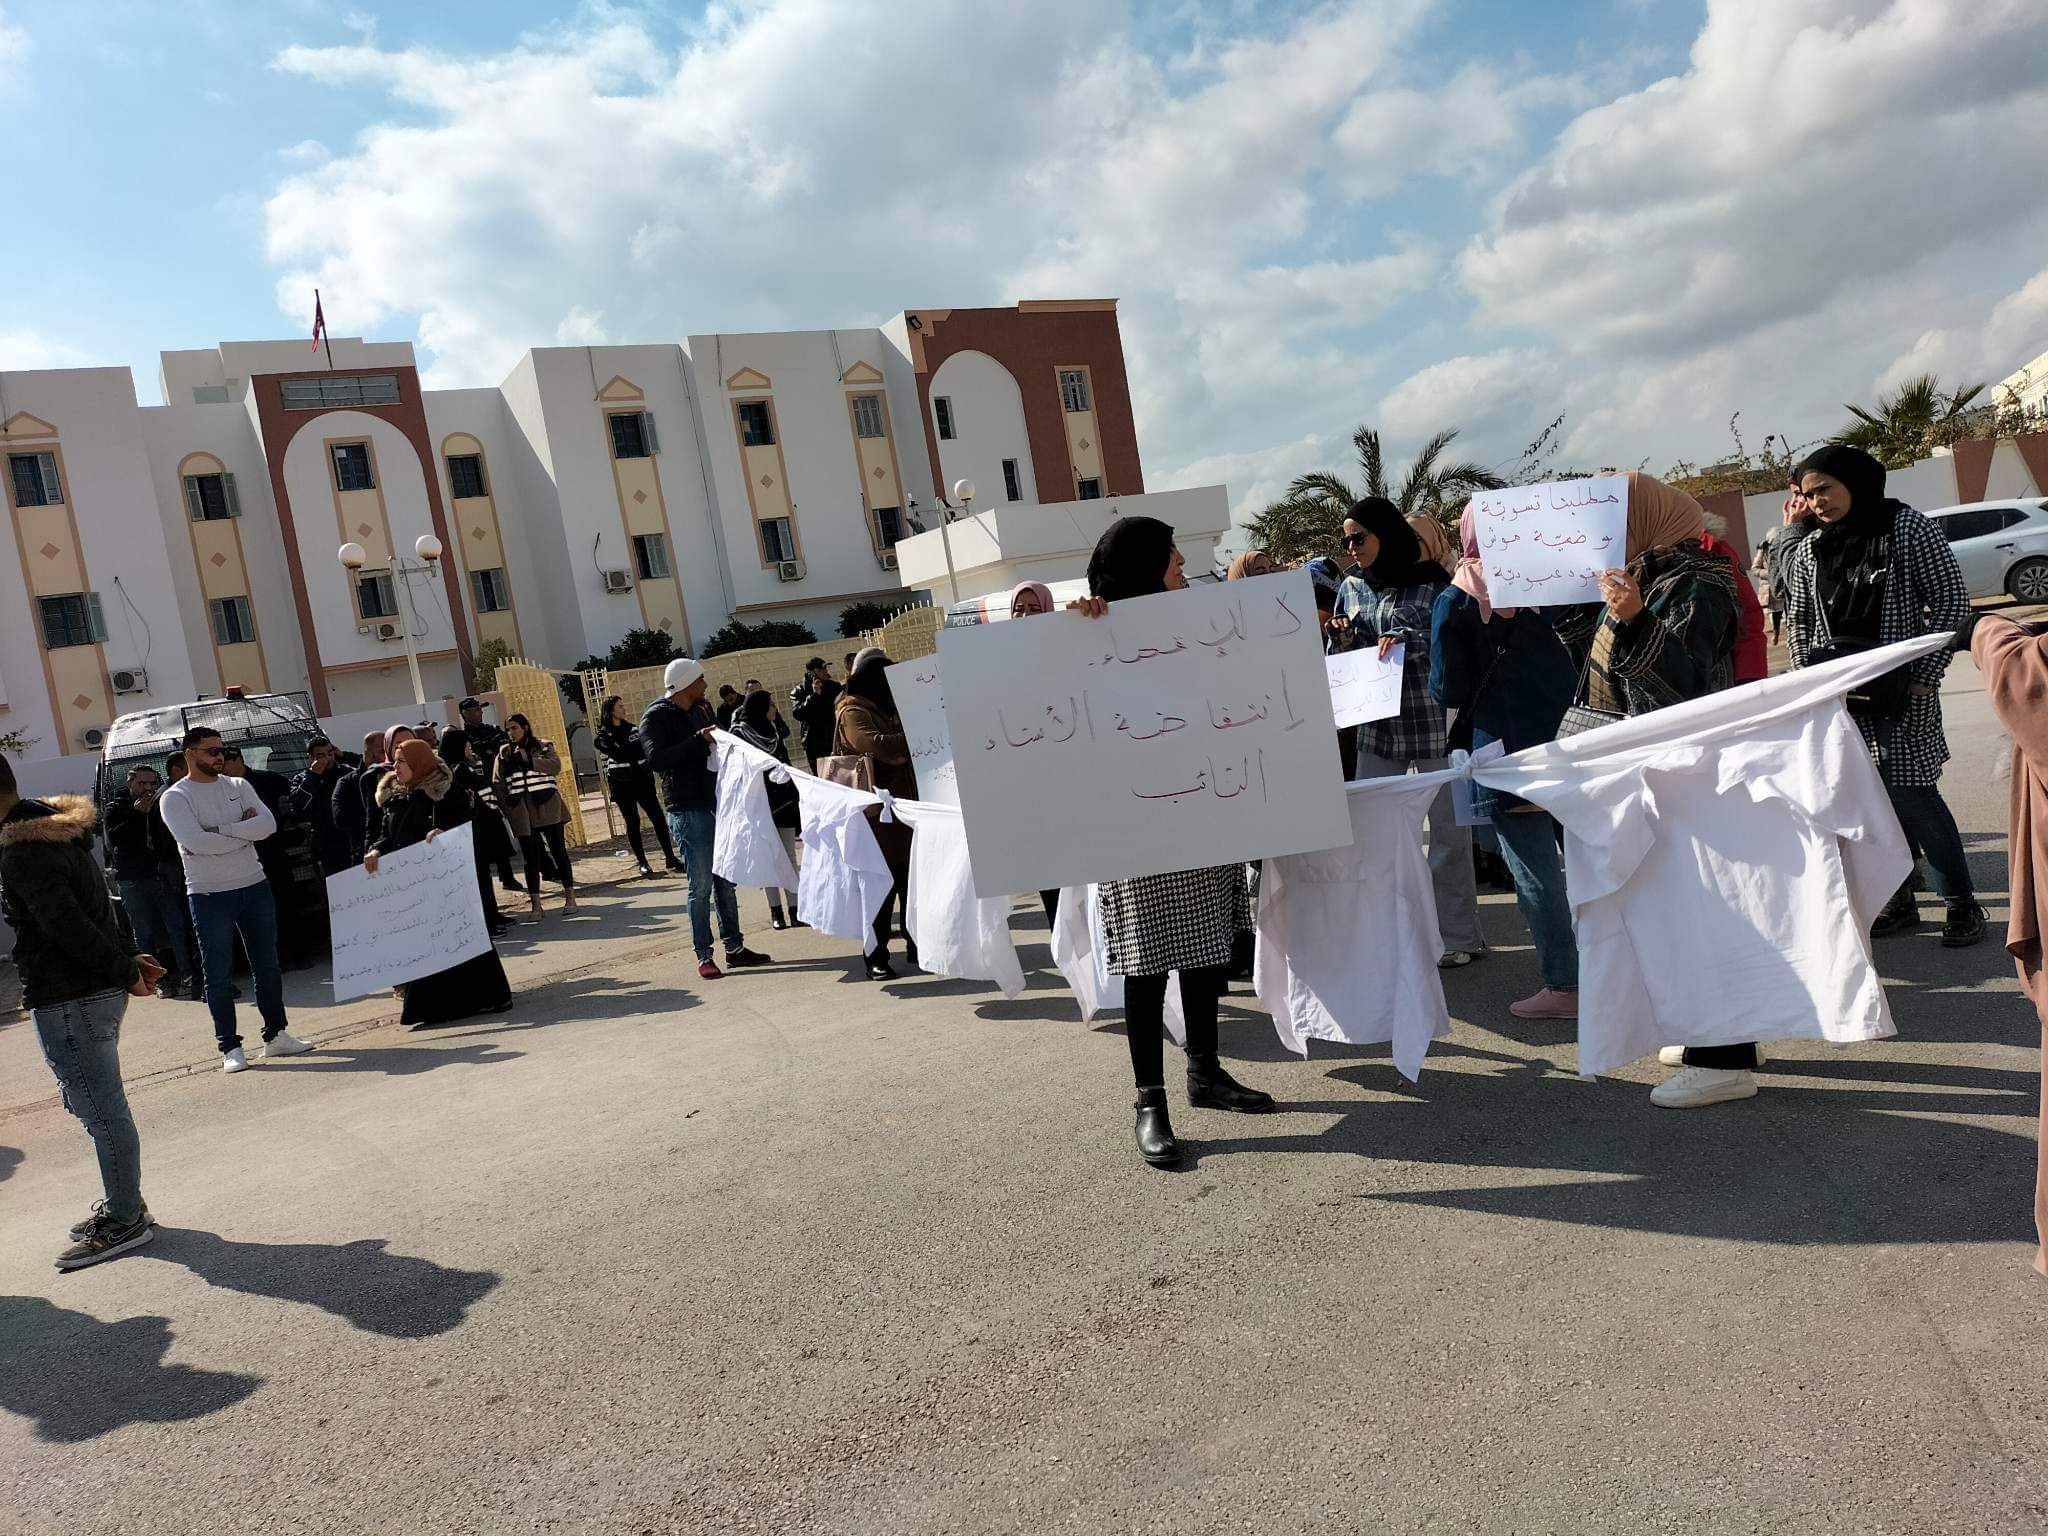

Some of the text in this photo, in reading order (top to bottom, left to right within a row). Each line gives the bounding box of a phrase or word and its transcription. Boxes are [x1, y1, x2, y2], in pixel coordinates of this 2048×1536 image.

[1549, 486, 1620, 516] مطلبنا
[952, 614, 977, 627] POLICE
[1270, 591, 1302, 637] لا
[1130, 747, 1269, 804] النائب
